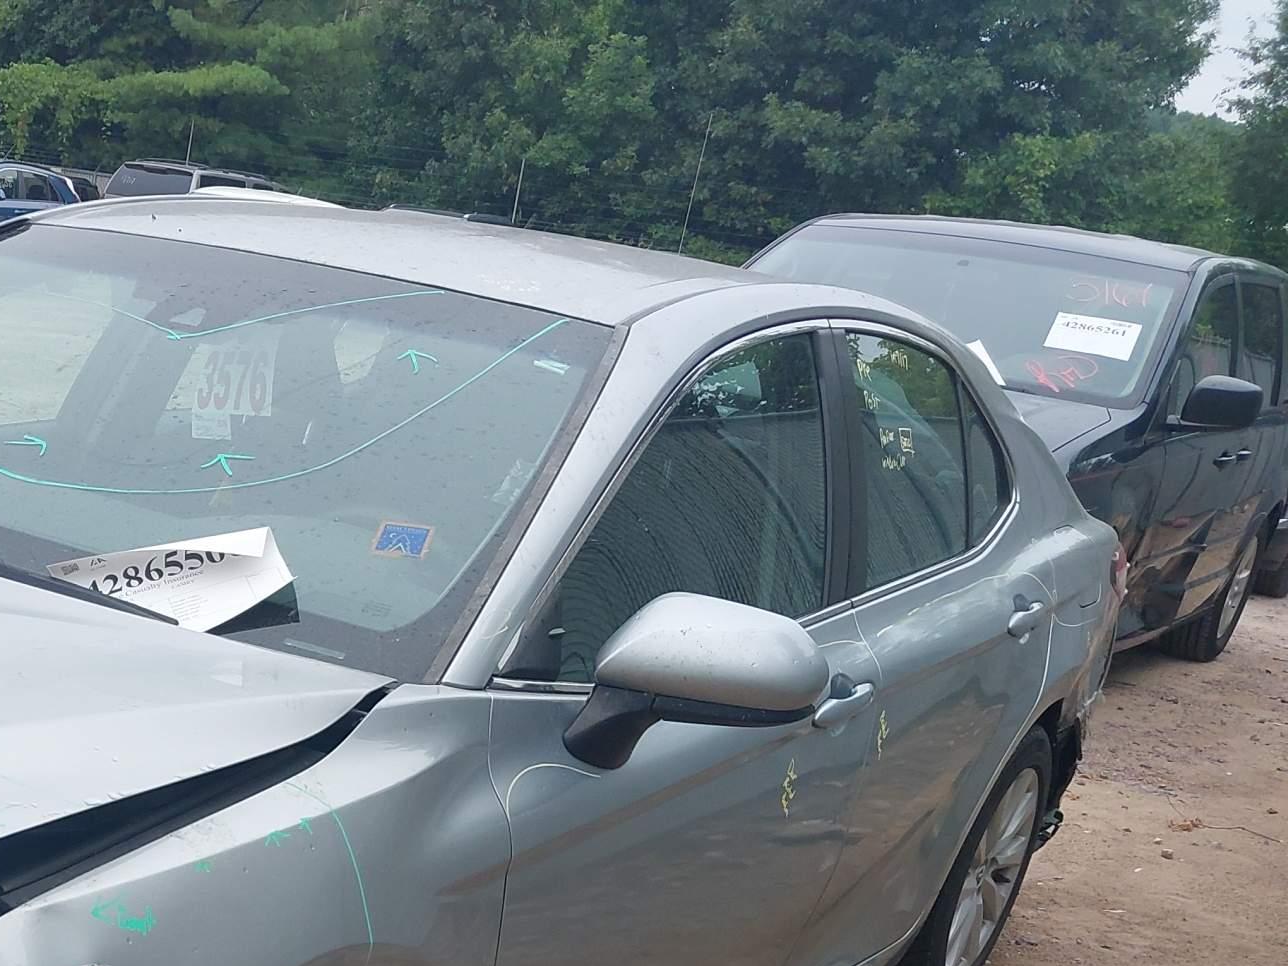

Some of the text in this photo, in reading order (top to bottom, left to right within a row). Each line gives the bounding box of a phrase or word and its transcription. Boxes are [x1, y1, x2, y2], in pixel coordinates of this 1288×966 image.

[1062, 320, 1127, 337] 42865261
[197, 348, 268, 413] 3576
[164, 569, 205, 585] Insurance
